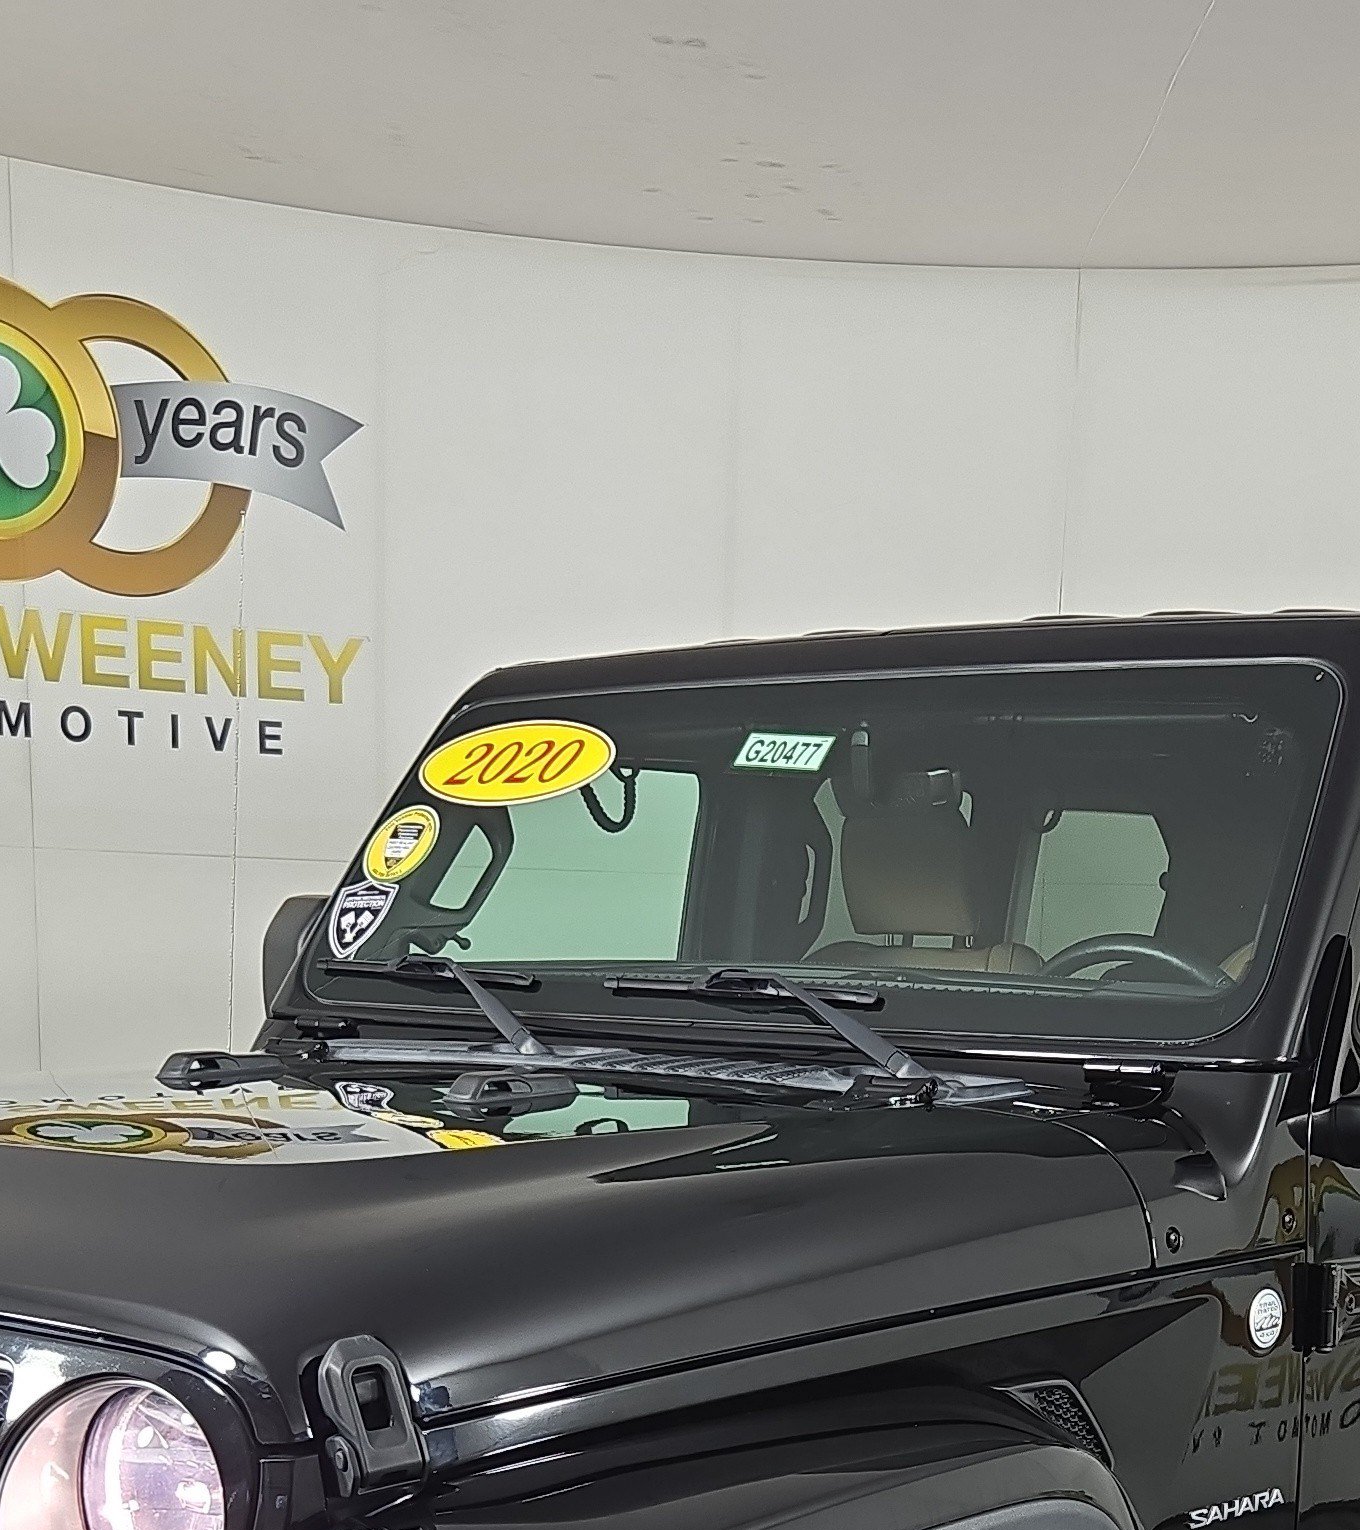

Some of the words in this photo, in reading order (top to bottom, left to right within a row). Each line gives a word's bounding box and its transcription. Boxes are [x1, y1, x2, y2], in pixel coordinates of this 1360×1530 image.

[133, 396, 309, 468] years
[442, 738, 586, 786] 2020
[745, 739, 824, 766] G20477
[342, 899, 386, 910] PROTECTION
[1186, 1487, 1285, 1530] SAHARA
